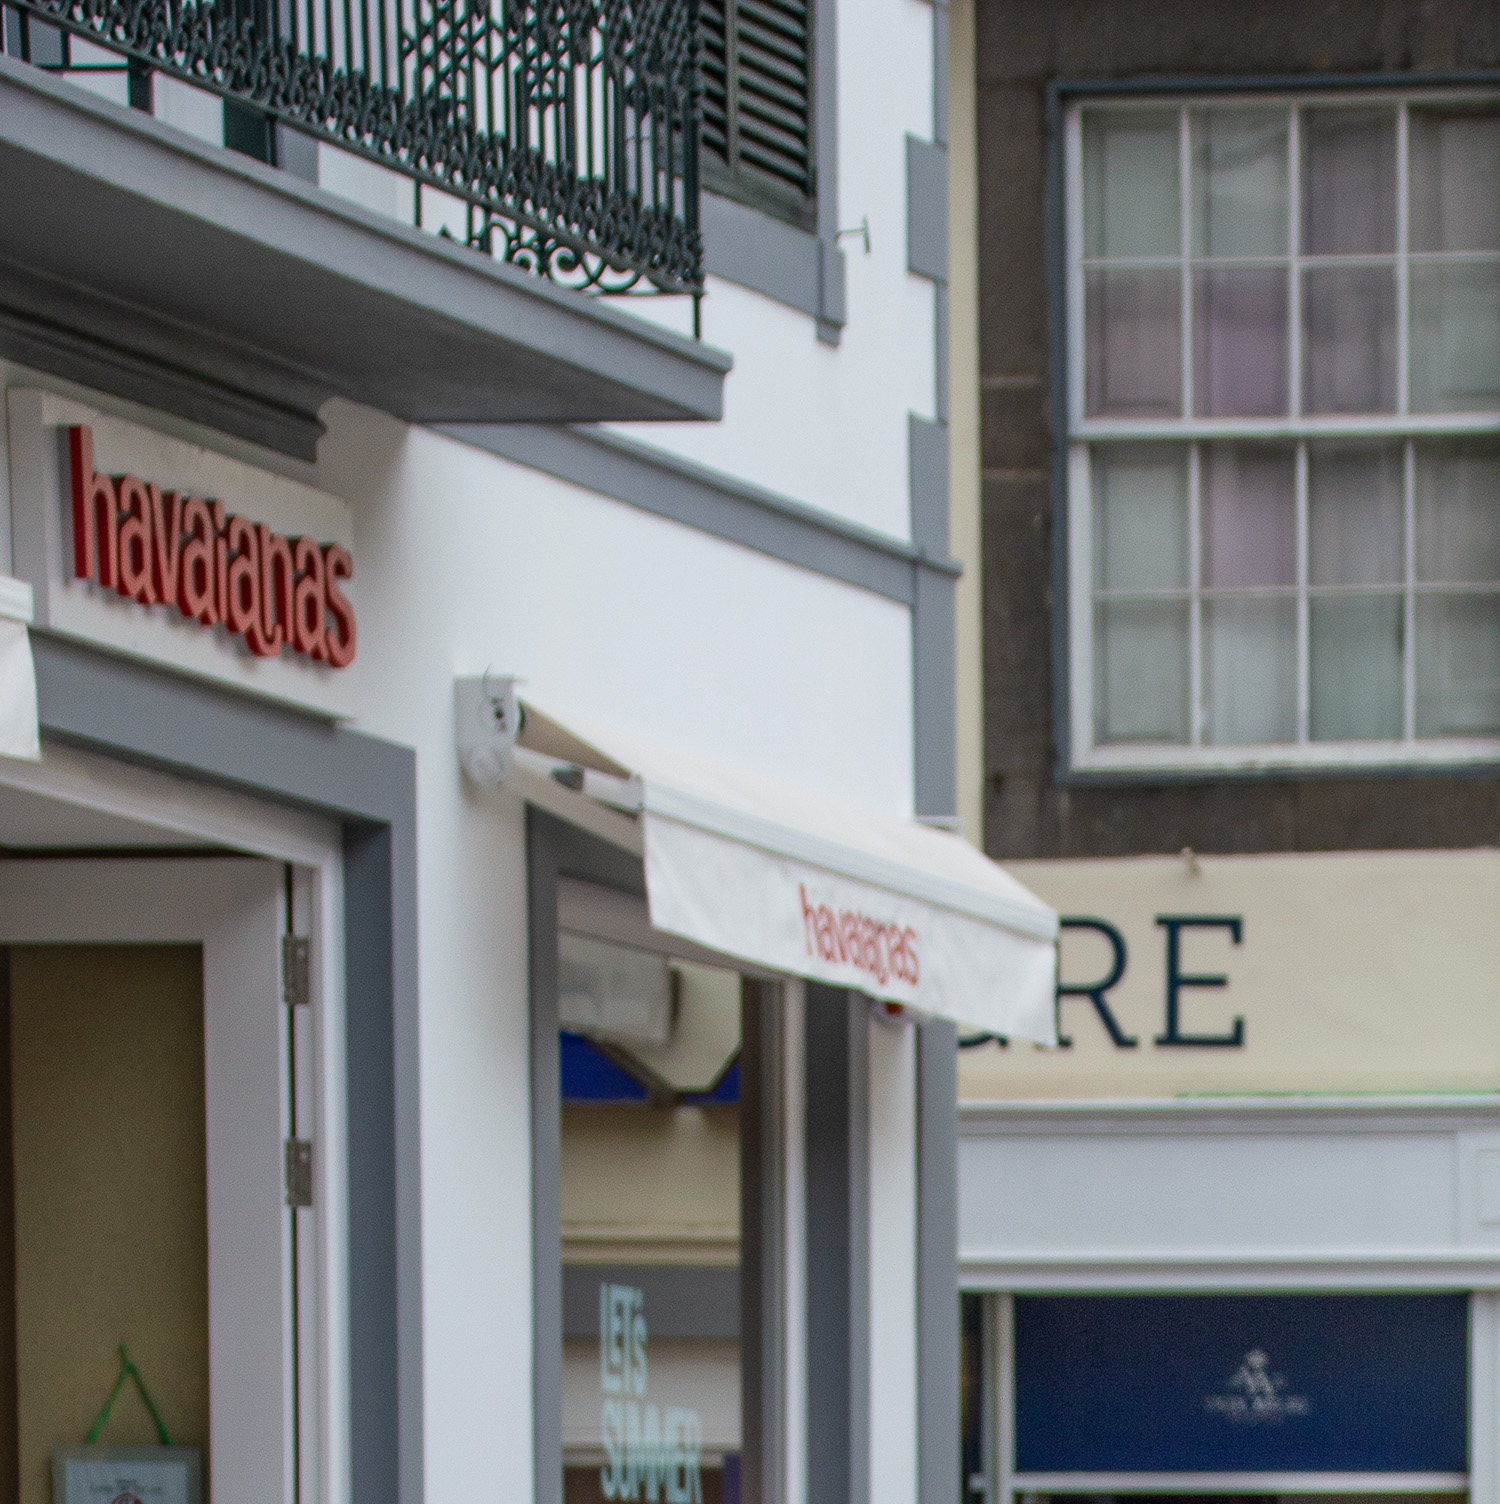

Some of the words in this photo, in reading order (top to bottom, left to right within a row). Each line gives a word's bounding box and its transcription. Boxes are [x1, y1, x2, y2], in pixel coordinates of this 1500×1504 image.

[67, 424, 357, 669] havaianas
[799, 882, 920, 987] havaianas
[957, 914, 1245, 1049] RE
